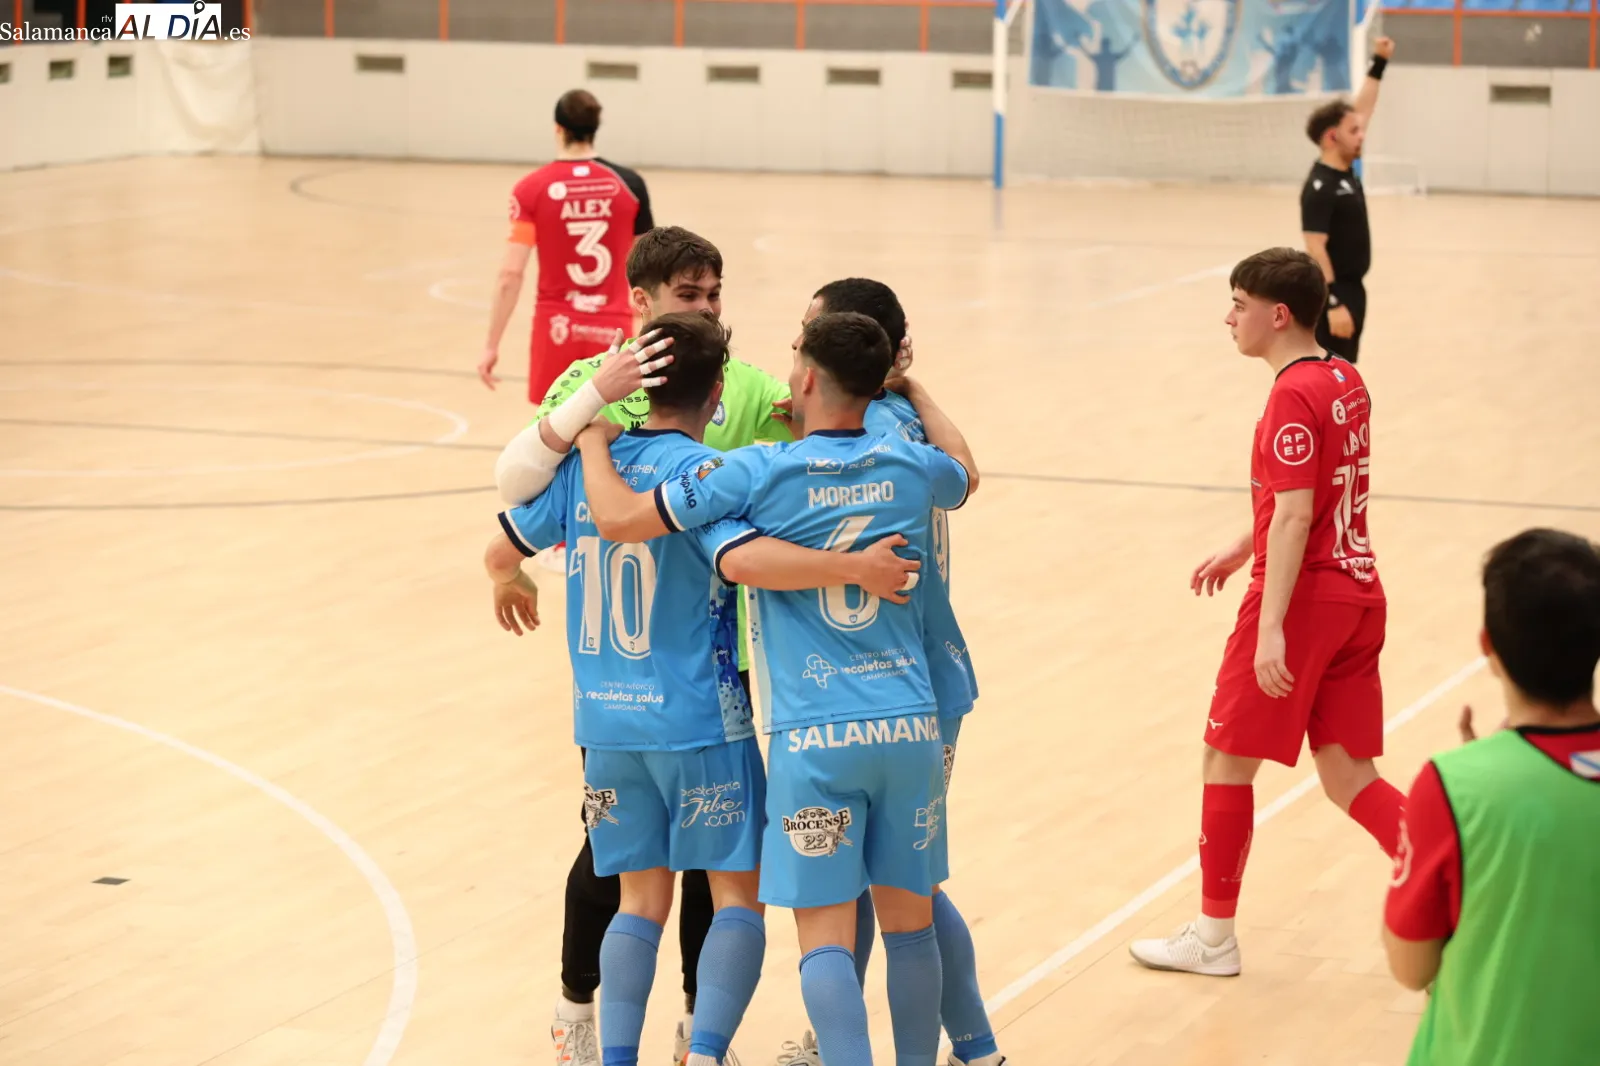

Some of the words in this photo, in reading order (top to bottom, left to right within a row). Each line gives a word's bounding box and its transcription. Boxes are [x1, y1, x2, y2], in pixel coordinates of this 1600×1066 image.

[560, 199, 613, 219] ALEX
[565, 220, 612, 286] 3
[1282, 431, 1305, 444] RF
[1284, 444, 1307, 456] EF
[619, 463, 658, 474] KITCHEN
[807, 480, 894, 509] MOREIRO
[1332, 456, 1370, 558] 15
[817, 514, 880, 632] 6
[568, 536, 657, 660] 10
[849, 651, 880, 661] CENTRO
[841, 658, 893, 674] recoletas
[586, 689, 634, 702] recoletas
[704, 809, 746, 828] .com
[782, 809, 850, 833] BROCENSE
[803, 833, 828, 851] 22
